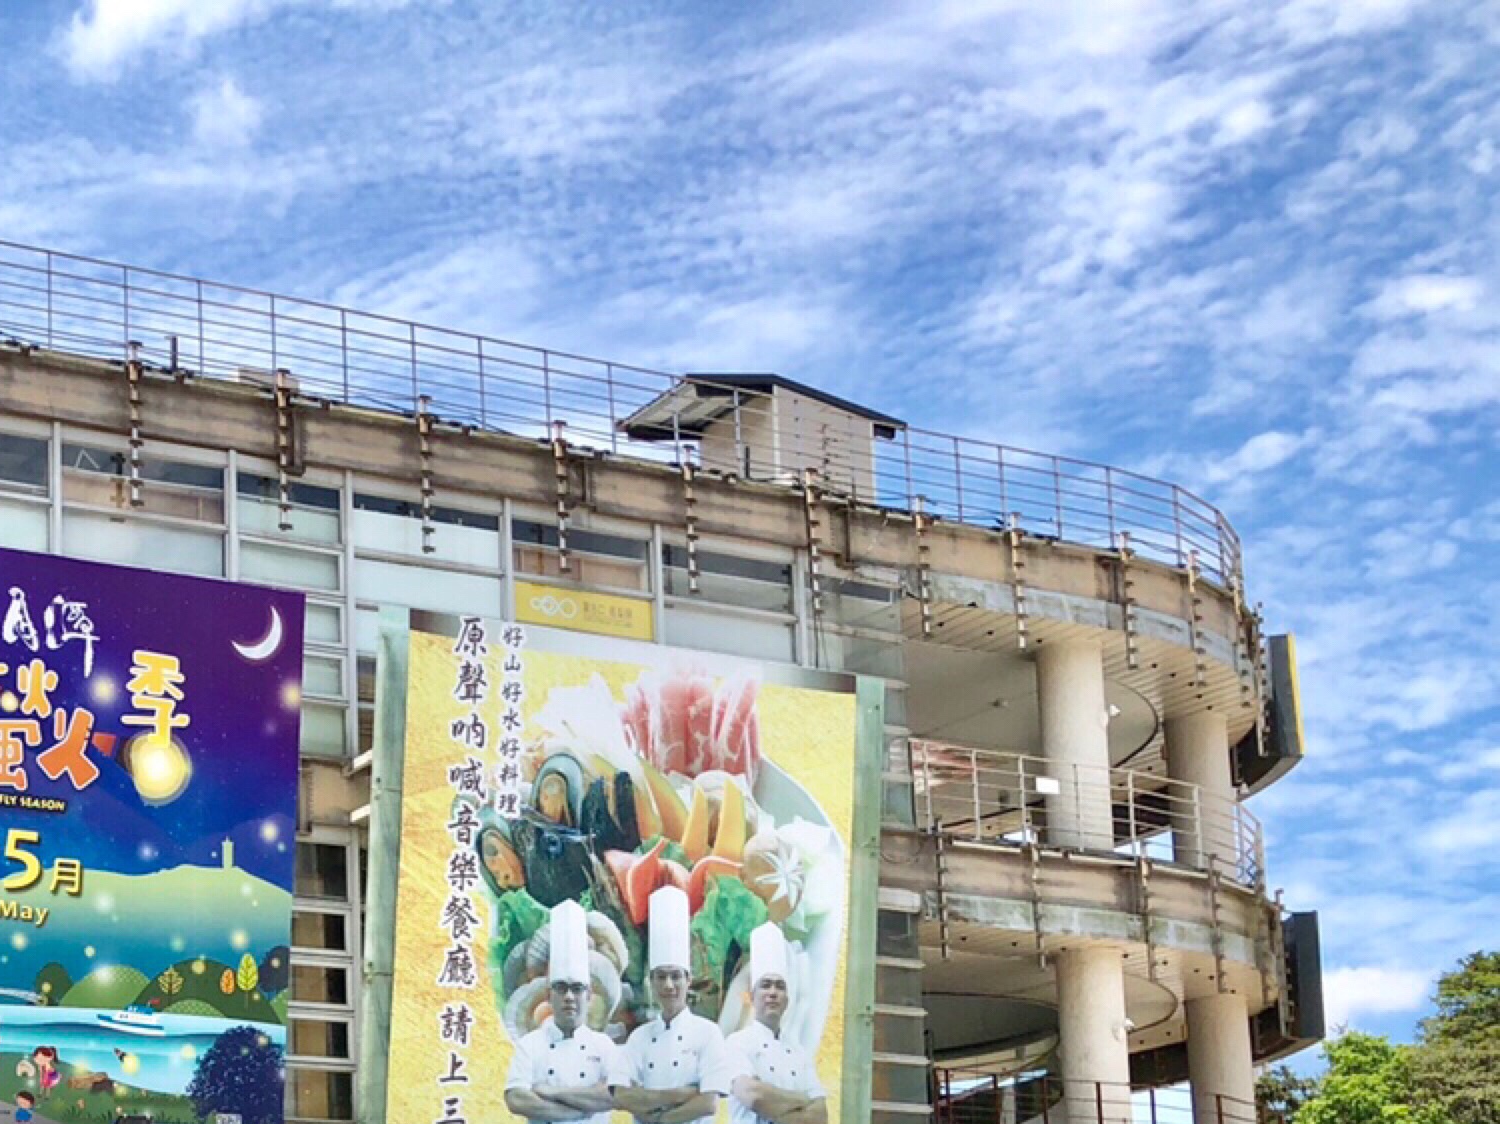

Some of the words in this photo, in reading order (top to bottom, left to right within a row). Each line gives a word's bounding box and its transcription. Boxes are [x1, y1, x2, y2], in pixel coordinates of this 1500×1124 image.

[497, 626, 526, 818] 好山好水好料理
